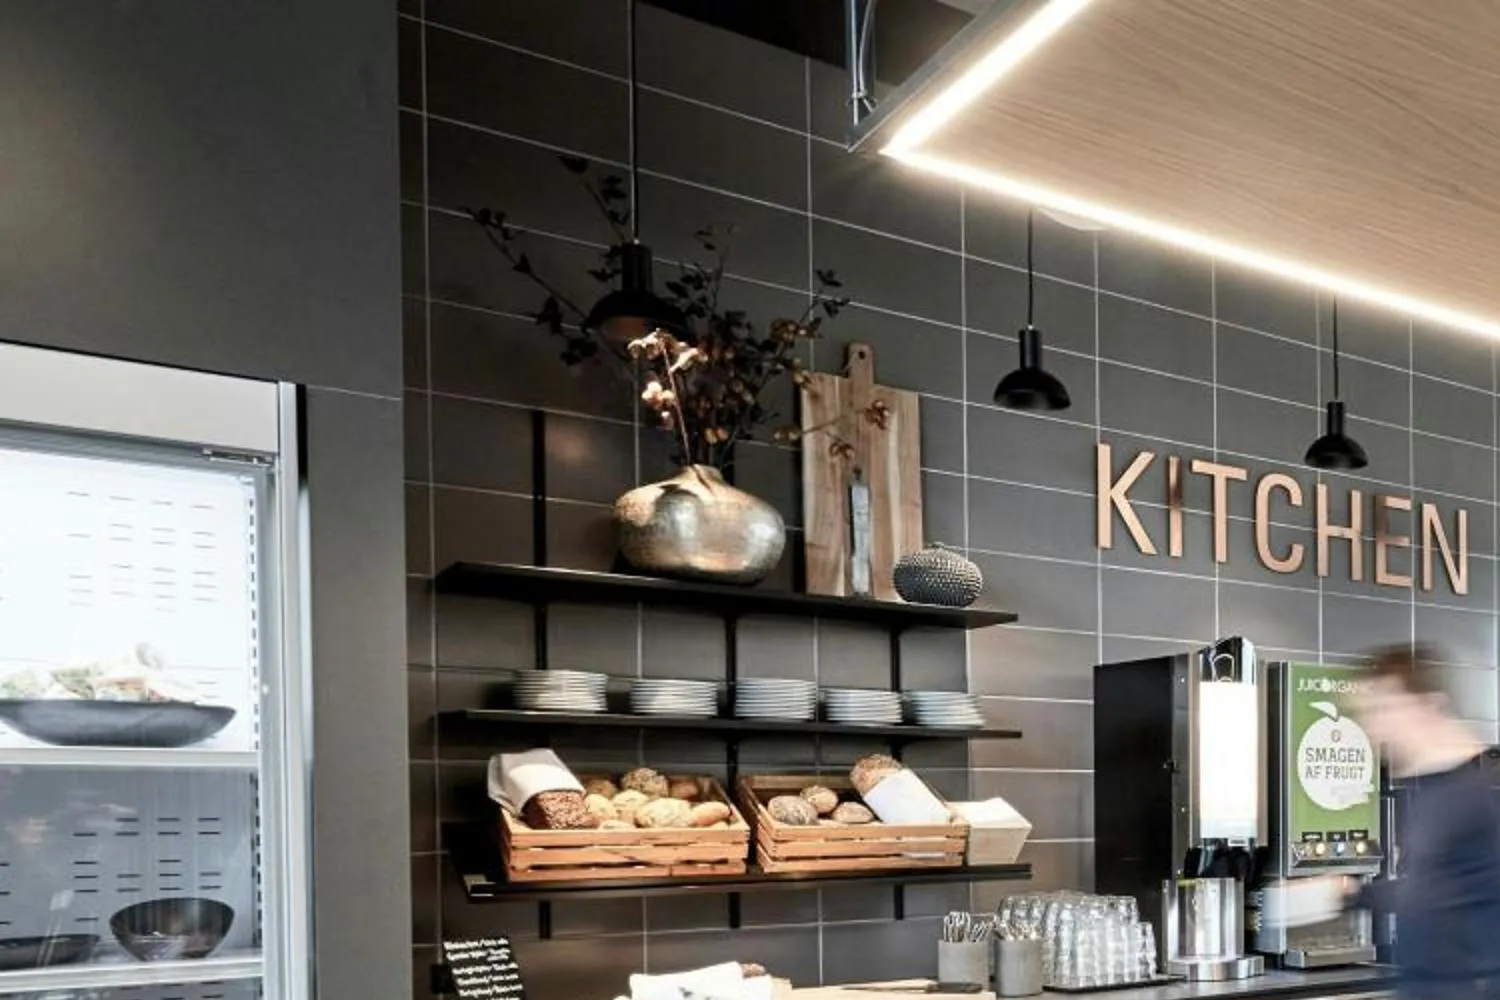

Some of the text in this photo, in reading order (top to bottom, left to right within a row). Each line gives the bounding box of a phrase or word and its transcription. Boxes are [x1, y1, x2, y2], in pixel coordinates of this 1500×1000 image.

[1096, 442, 1468, 596] KITCHEN
[1305, 747, 1365, 763] SMAGEN
[1305, 765, 1365, 780] AF FRUGT
